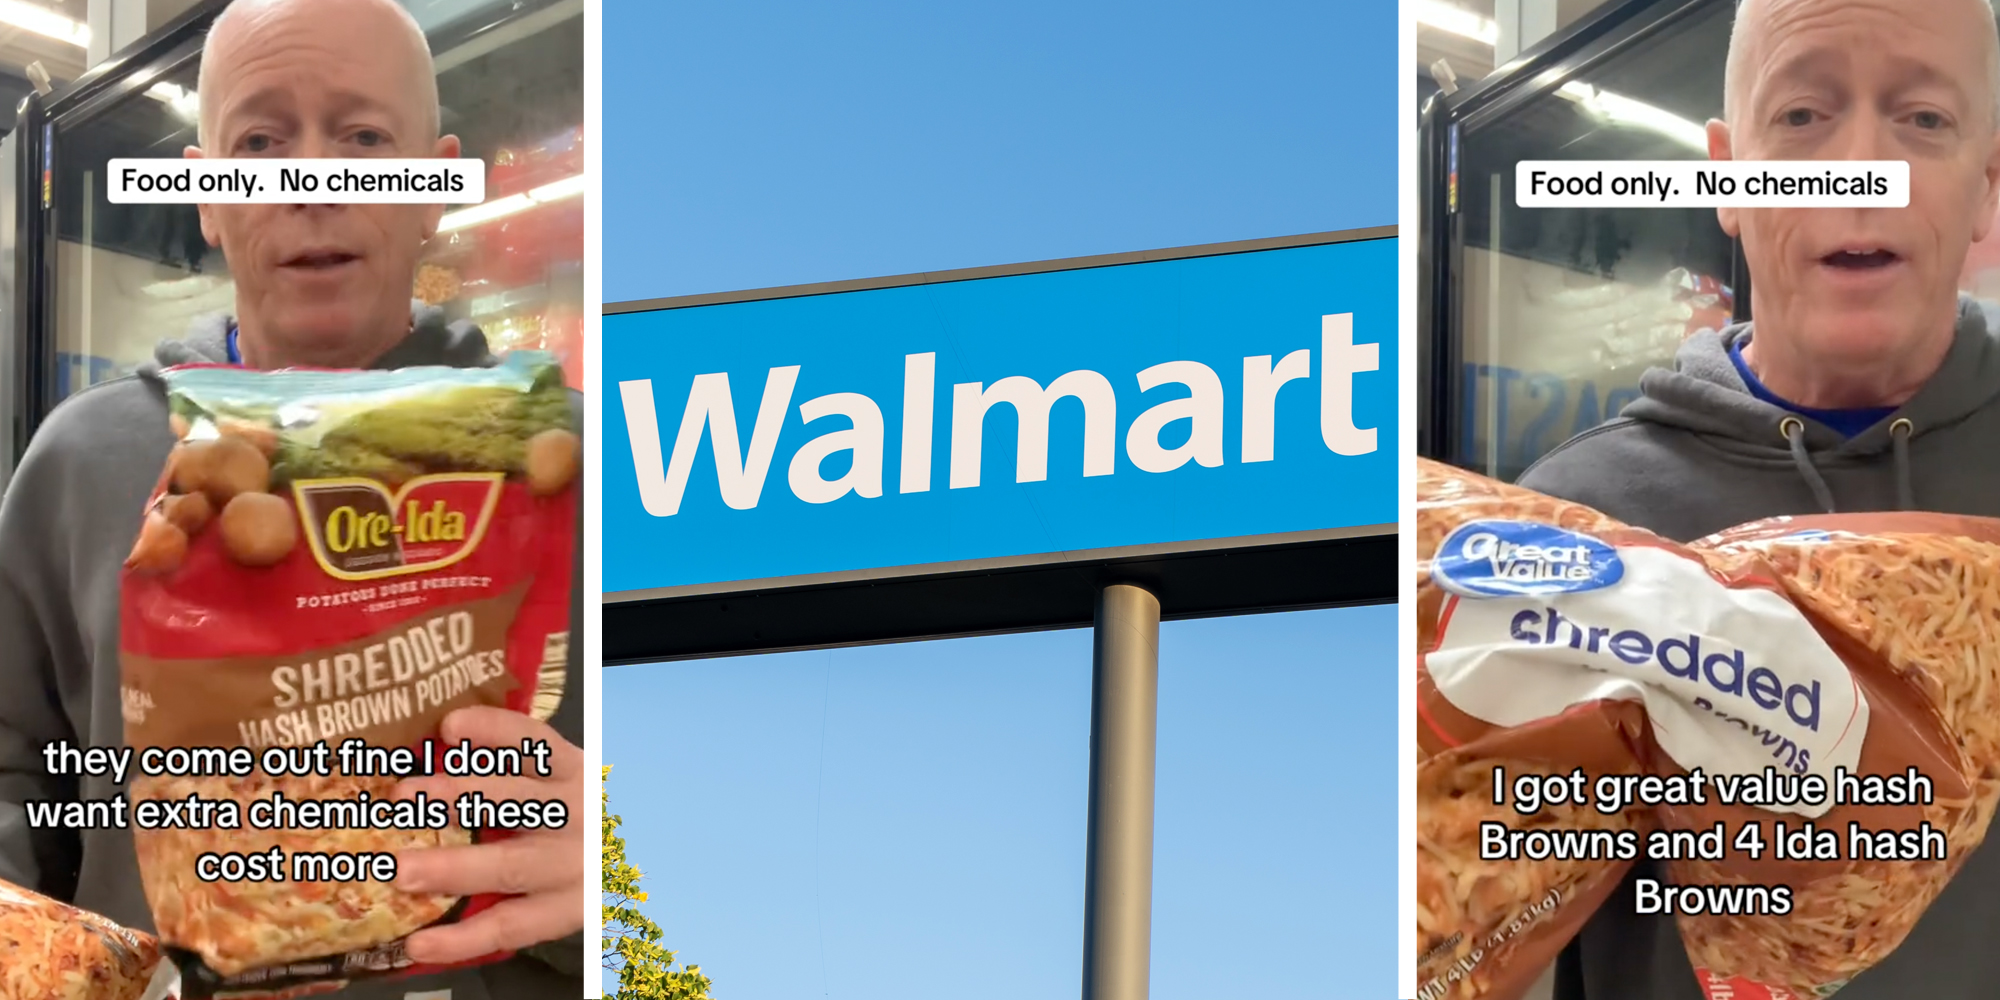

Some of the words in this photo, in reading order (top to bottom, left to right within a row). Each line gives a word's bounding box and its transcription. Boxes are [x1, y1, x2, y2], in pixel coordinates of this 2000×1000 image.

[618, 312, 1380, 517] Walmart
[325, 500, 467, 553] Ore-Ida
[1461, 532, 1591, 564] Great
[1489, 556, 1593, 583] Value
[270, 610, 474, 708] SHREDDED
[237, 708, 315, 748] HASH
[316, 686, 412, 738] BROWN
[415, 648, 506, 714] POTATOES
